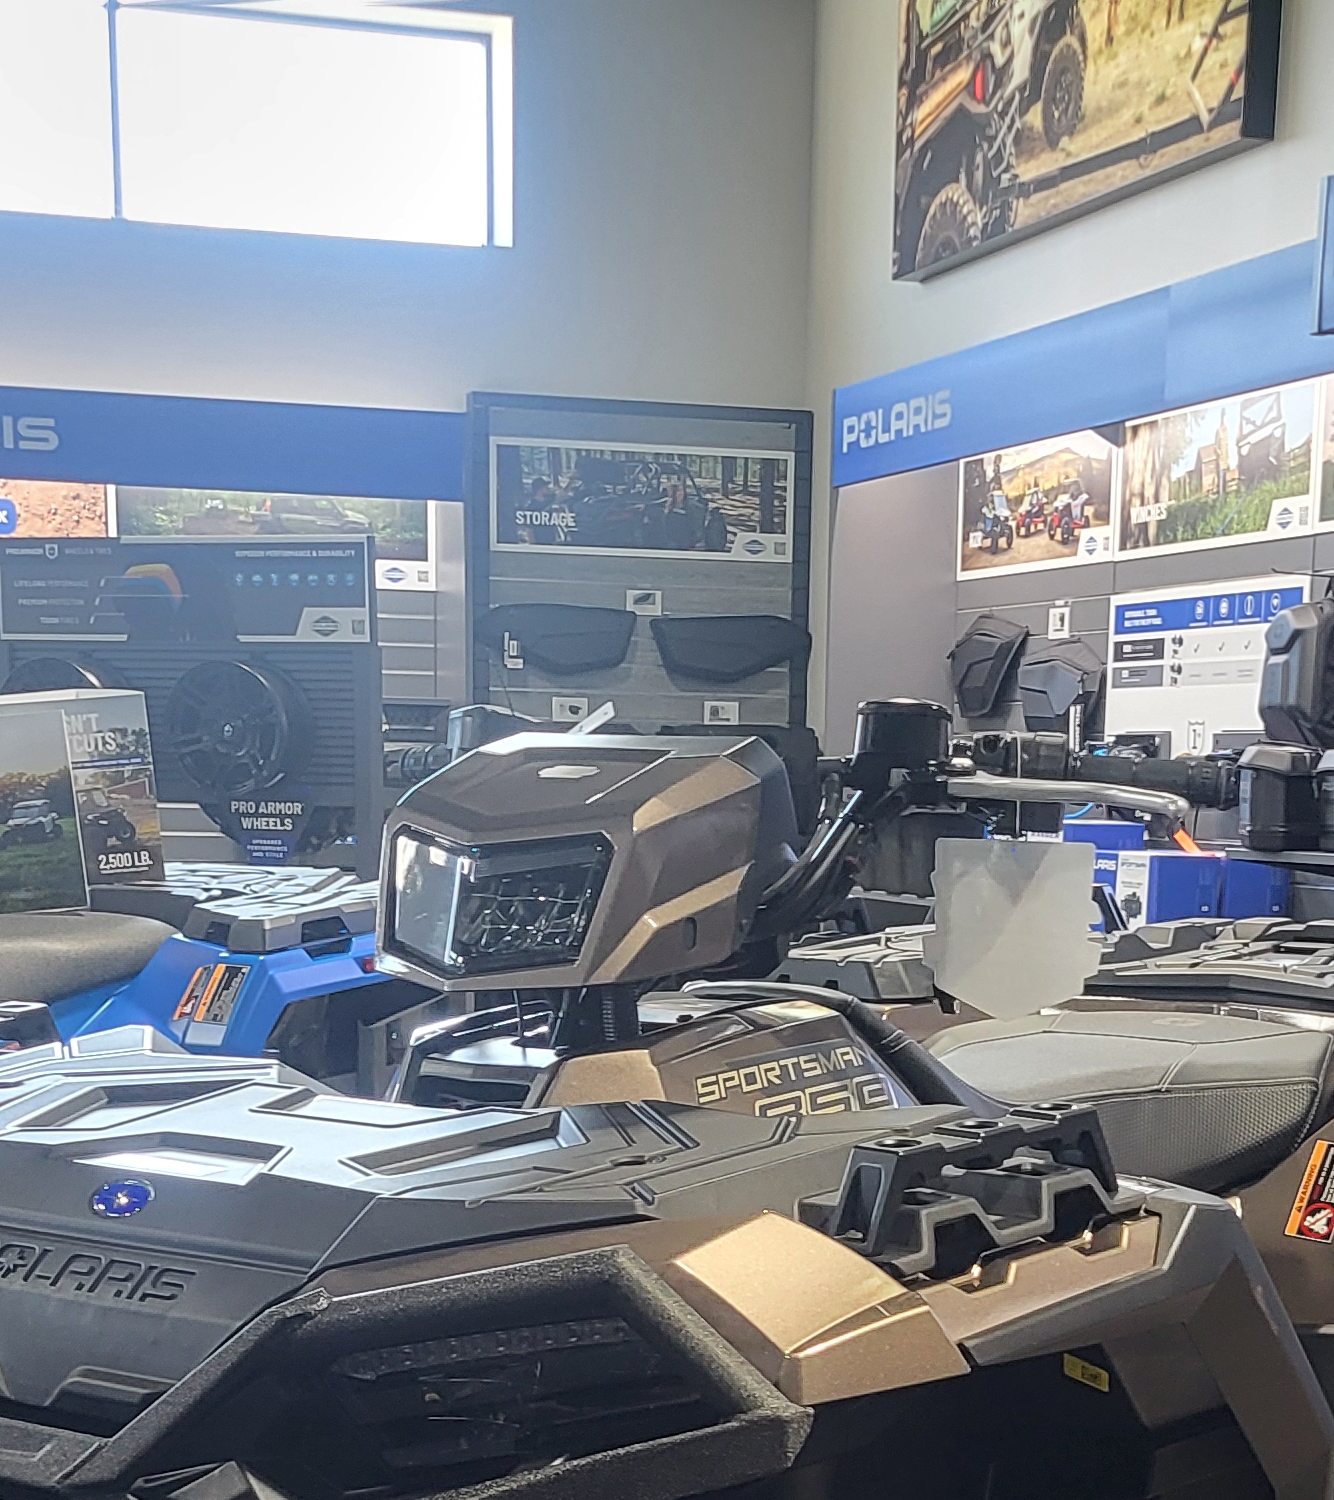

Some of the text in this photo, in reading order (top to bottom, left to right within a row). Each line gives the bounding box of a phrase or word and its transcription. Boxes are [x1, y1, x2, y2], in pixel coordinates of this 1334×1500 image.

[841, 390, 953, 454] POLARIS
[515, 510, 576, 528] STORAGE
[1130, 502, 1166, 524] WINCHES
[69, 732, 117, 753] CUTS
[230, 800, 302, 815] PRO ARMOR
[240, 816, 293, 831] WHEELS
[98, 851, 154, 870] 2,500 LB.
[1297, 1163, 1318, 1206] WARNING
